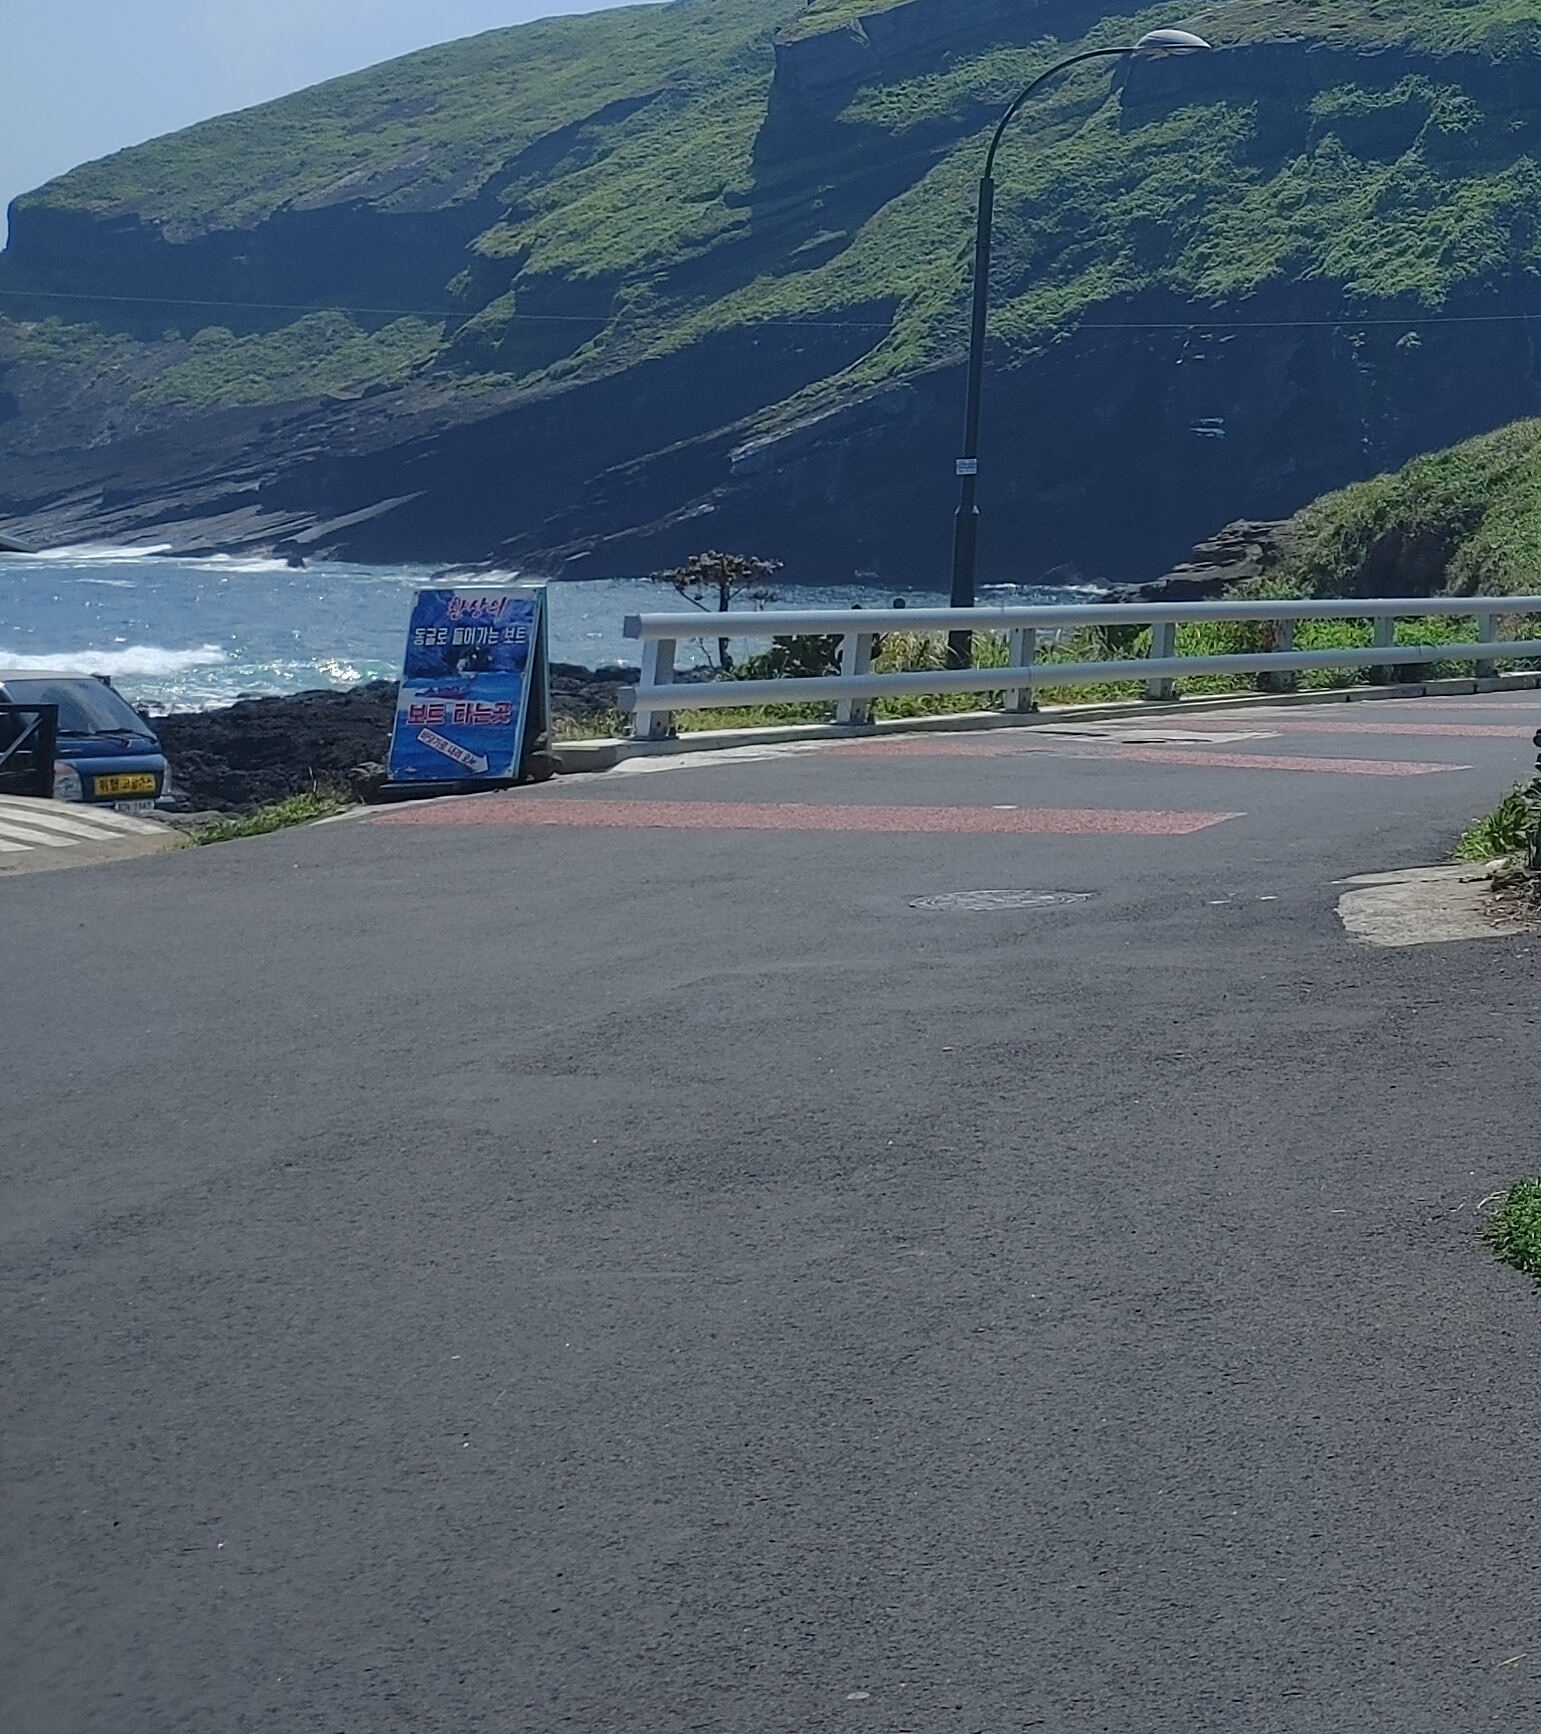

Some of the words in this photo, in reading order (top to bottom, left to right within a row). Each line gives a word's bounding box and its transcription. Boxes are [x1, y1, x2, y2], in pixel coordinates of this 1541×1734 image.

[447, 596, 508, 620] 환상의
[414, 627, 447, 646] 동굴로
[452, 626, 500, 646] 들어가는
[503, 626, 527, 644] 보트
[406, 703, 446, 726] 보트
[451, 702, 512, 725] 타는곳
